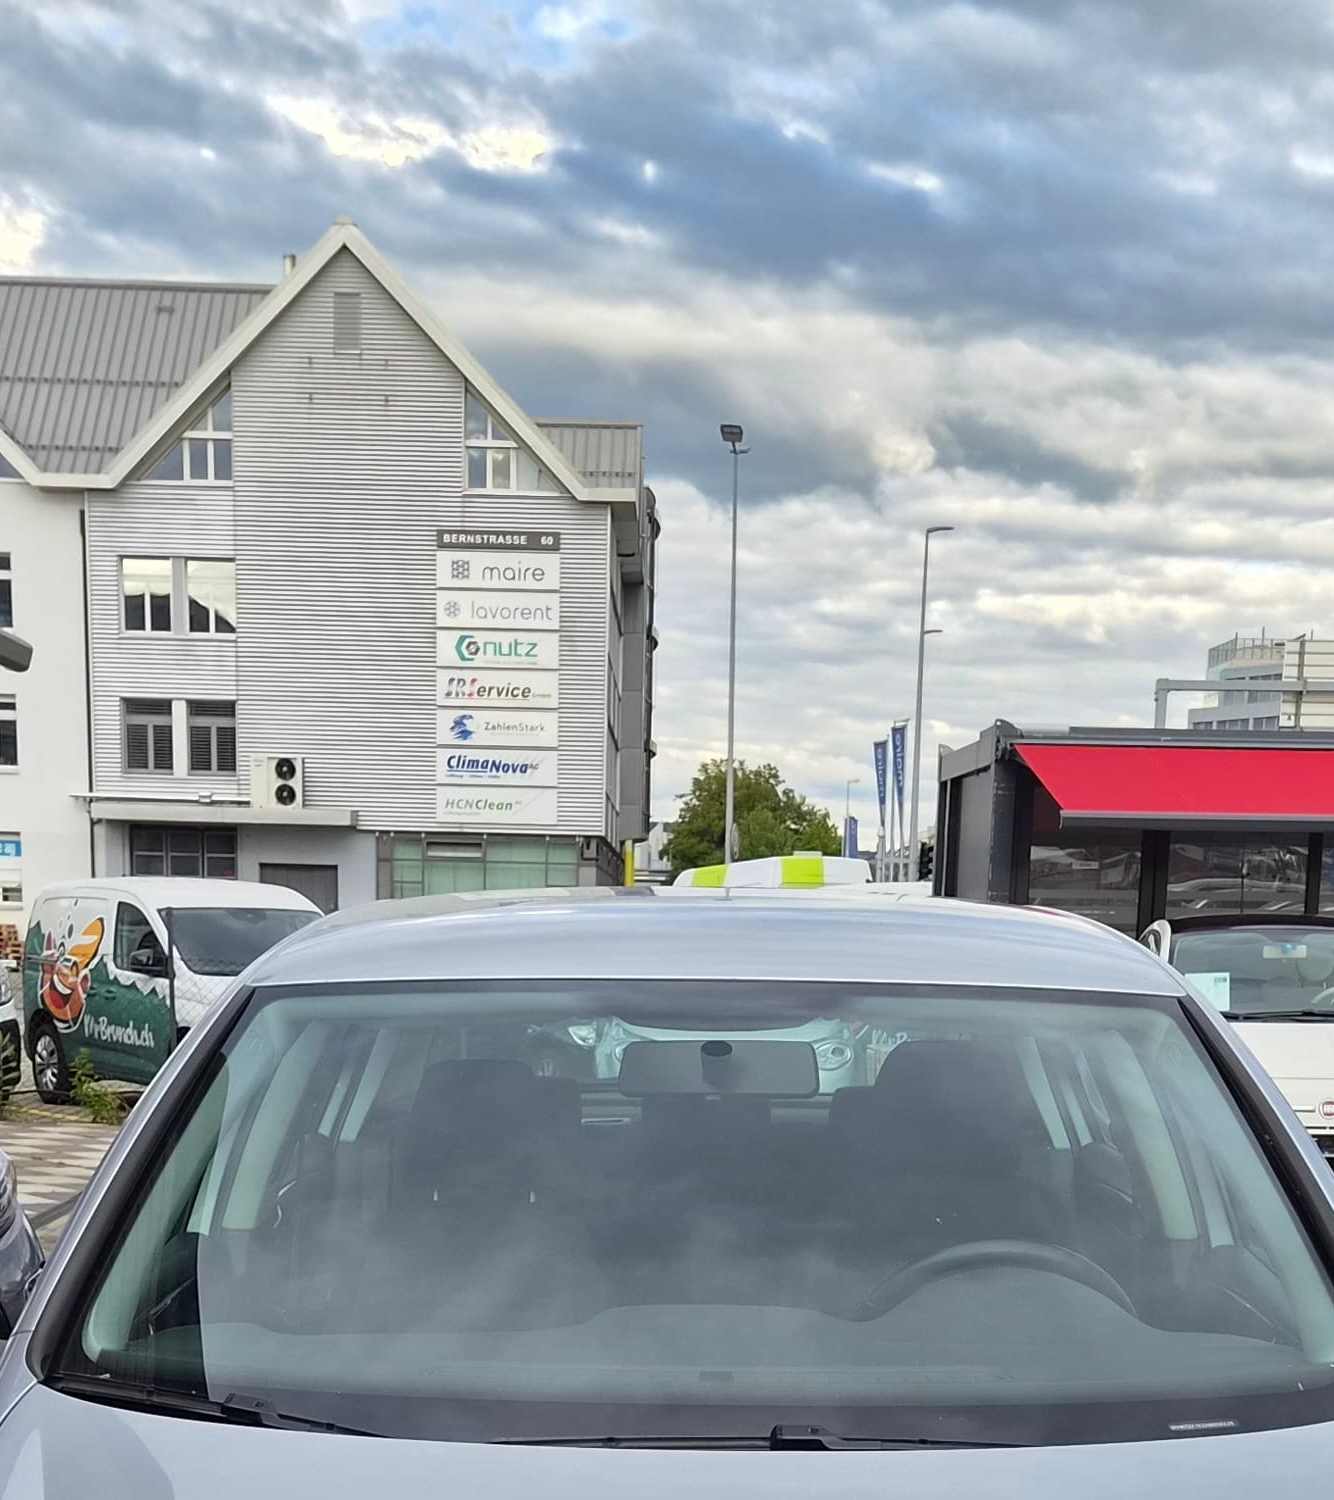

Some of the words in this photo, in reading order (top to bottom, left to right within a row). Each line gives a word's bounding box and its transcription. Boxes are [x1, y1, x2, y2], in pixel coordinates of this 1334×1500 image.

[443, 534, 527, 545] BERNSTRASSE
[540, 536, 554, 545] 60
[482, 560, 545, 581] maire
[471, 600, 553, 620] lavorent
[483, 638, 538, 657] nutz
[484, 722, 545, 732] ZahlenStark
[447, 755, 528, 773] ClimaNova
[445, 799, 513, 811] HCNClean
